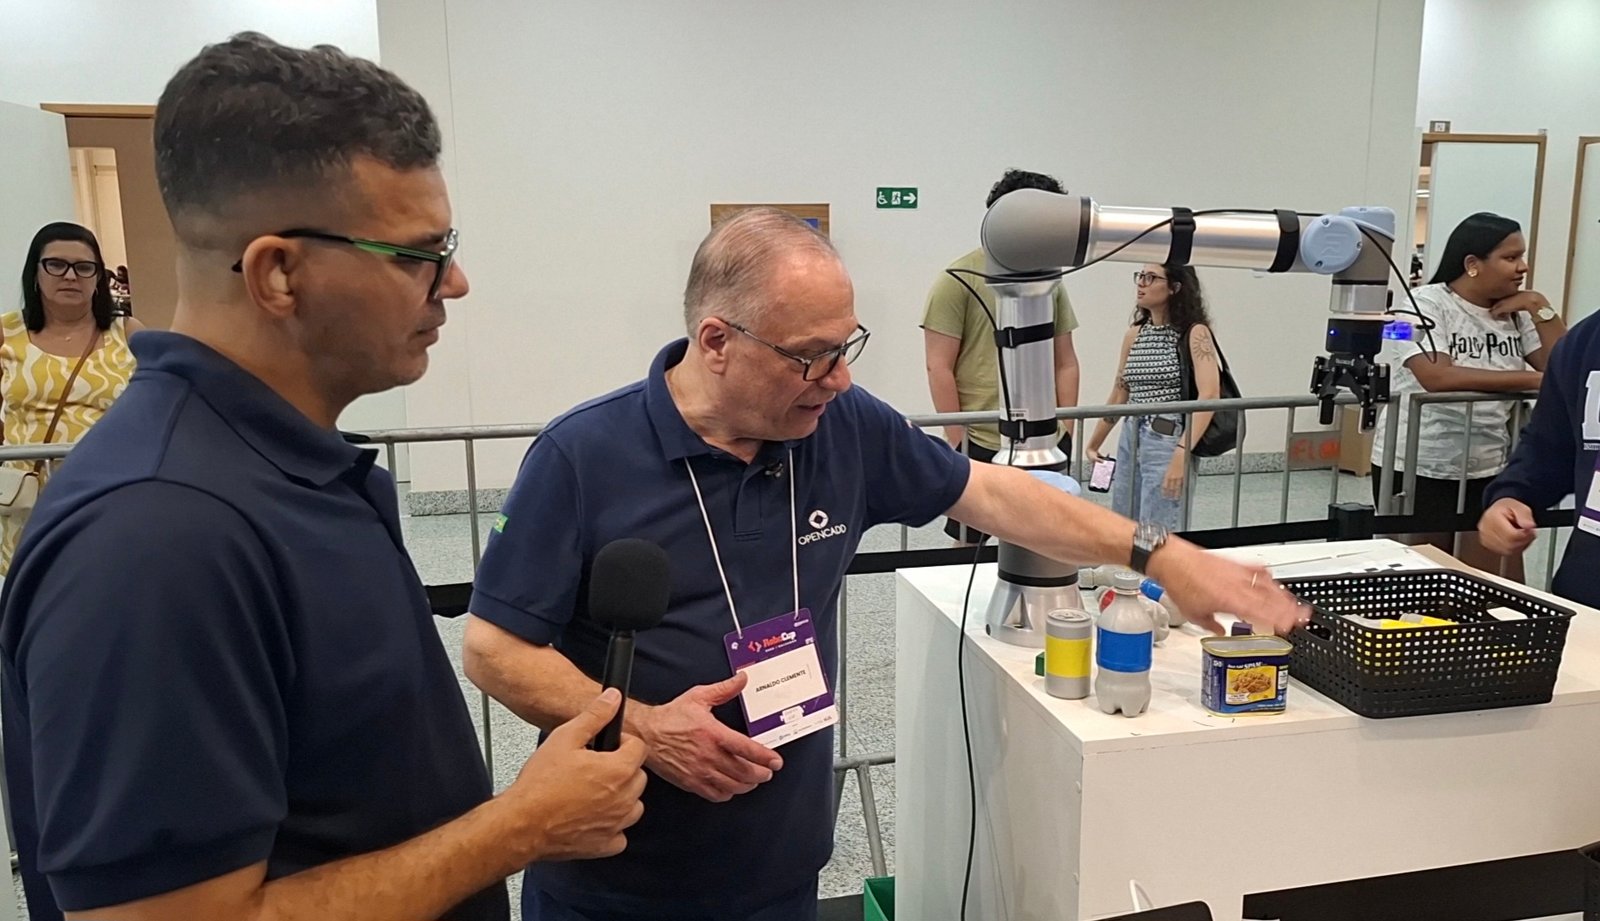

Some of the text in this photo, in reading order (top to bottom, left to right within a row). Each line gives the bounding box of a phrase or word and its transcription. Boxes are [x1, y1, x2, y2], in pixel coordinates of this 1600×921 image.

[798, 524, 847, 545] OPENCADD
[756, 670, 806, 692] ARNALDO CLEMENTE
